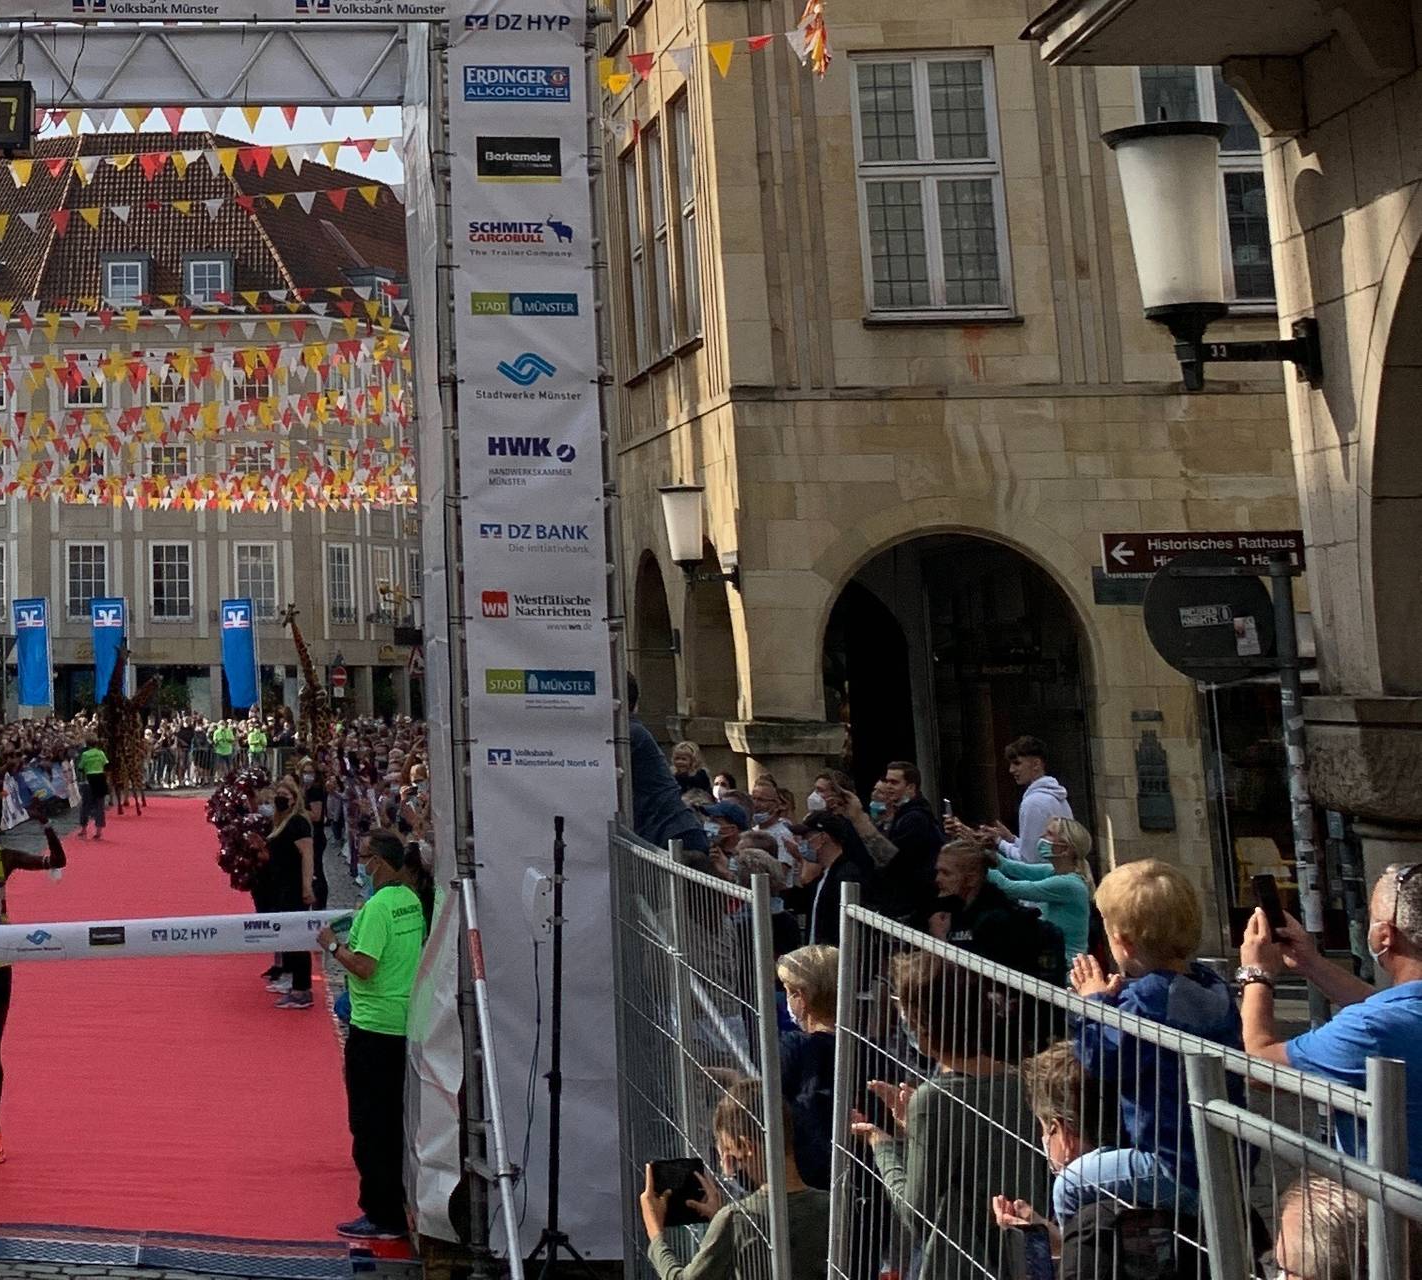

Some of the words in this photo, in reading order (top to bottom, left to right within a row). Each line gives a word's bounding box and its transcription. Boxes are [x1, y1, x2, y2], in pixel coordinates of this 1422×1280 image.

[110, 3, 168, 14] Volksbank
[170, 3, 219, 14] Münster
[334, 4, 394, 14] Volksbank
[397, 4, 445, 14] Münster
[495, 14, 522, 31] DZ
[527, 15, 571, 31] HYP
[466, 68, 548, 86] ERDINGER
[466, 87, 568, 97] ALKOHOLFREI
[469, 222, 544, 233] SCHMITZ
[469, 233, 545, 243] CARGOBULL
[526, 250, 573, 258] Company
[475, 301, 507, 312] STADT
[524, 300, 575, 313] MÜNSTER
[475, 390, 536, 400] Stadtwerke
[538, 390, 582, 400] Münster
[487, 436, 552, 457] HWK
[508, 524, 532, 539] DZ
[536, 524, 589, 540] BANK
[1147, 538, 1234, 551] Historisches
[1238, 537, 1296, 549] Rathaus
[514, 594, 591, 605] Westfälische
[483, 602, 508, 616] WN
[514, 606, 591, 617] Nachrichten
[489, 679, 523, 690] STADT
[540, 678, 591, 691] MÜNSTER
[514, 749, 554, 757] Volksbank
[243, 920, 271, 930] HWK
[171, 928, 188, 941] DZ
[191, 927, 218, 940] HYP
